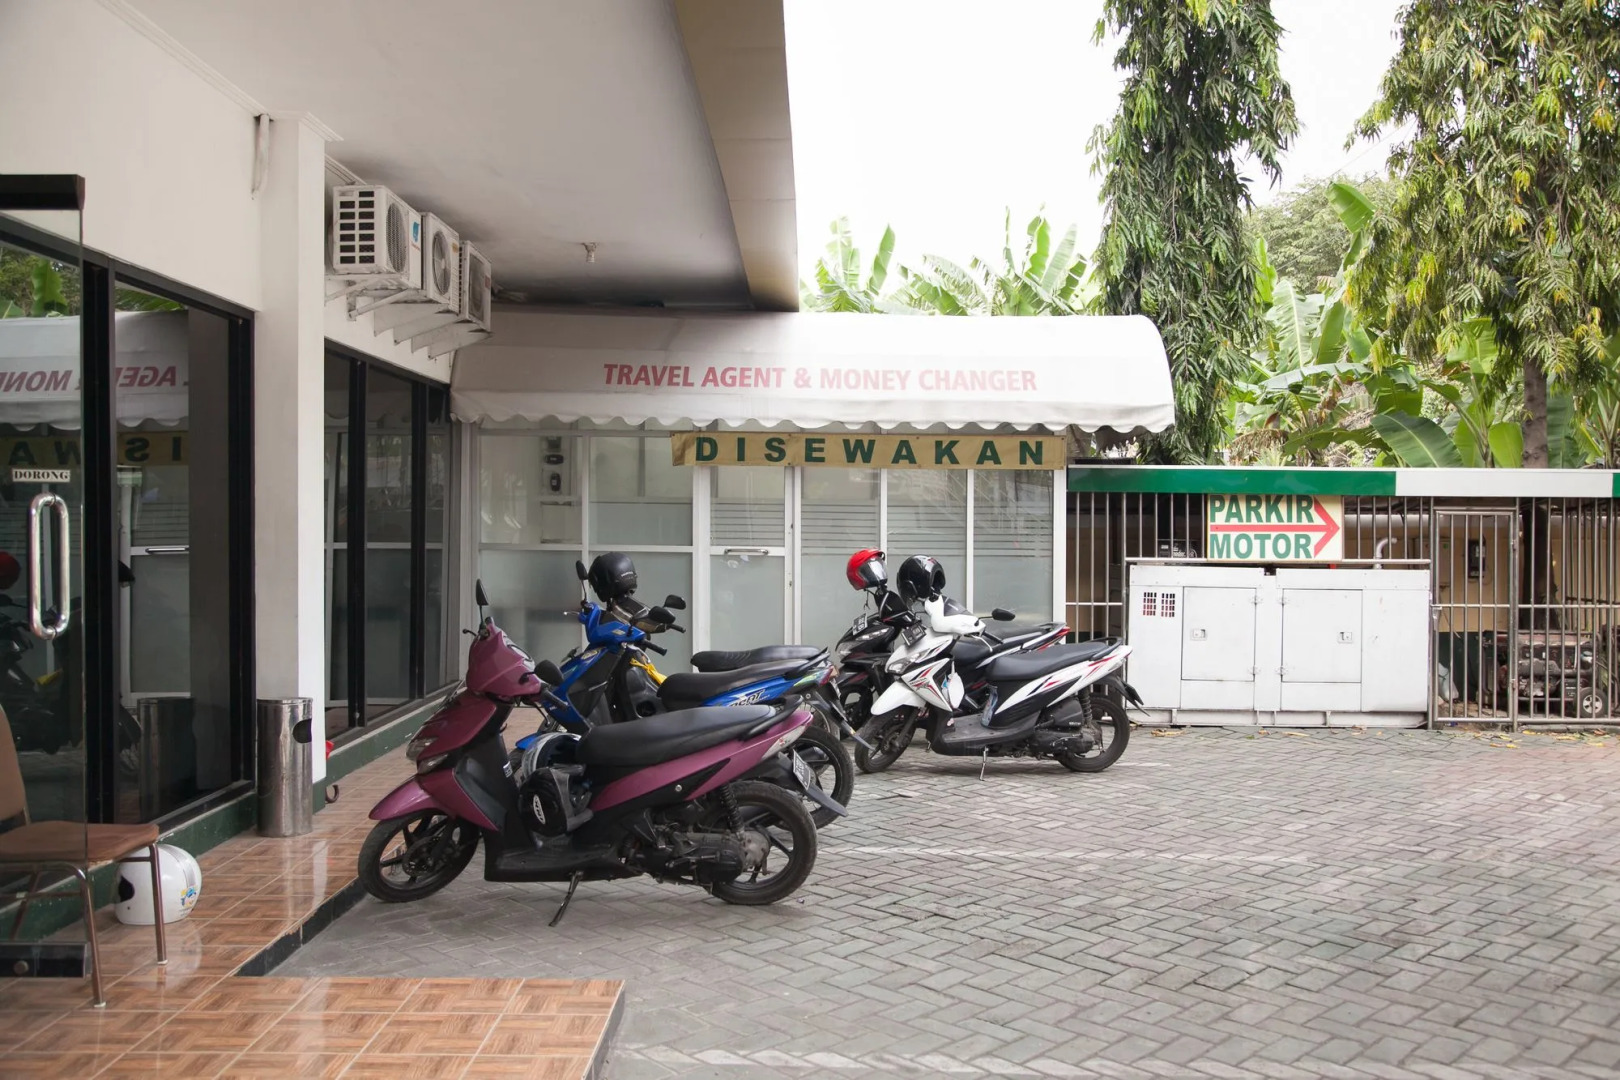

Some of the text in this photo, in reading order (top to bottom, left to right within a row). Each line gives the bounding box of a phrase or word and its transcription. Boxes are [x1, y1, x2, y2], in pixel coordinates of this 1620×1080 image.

[603, 363, 1038, 392] TRAVEL AGENT & MONEY CHANGER
[696, 436, 1044, 466] DISEWAKAN
[14, 470, 69, 480] DORONG
[1209, 494, 1314, 523] PARKIR
[1209, 533, 1312, 559] MOTOR
